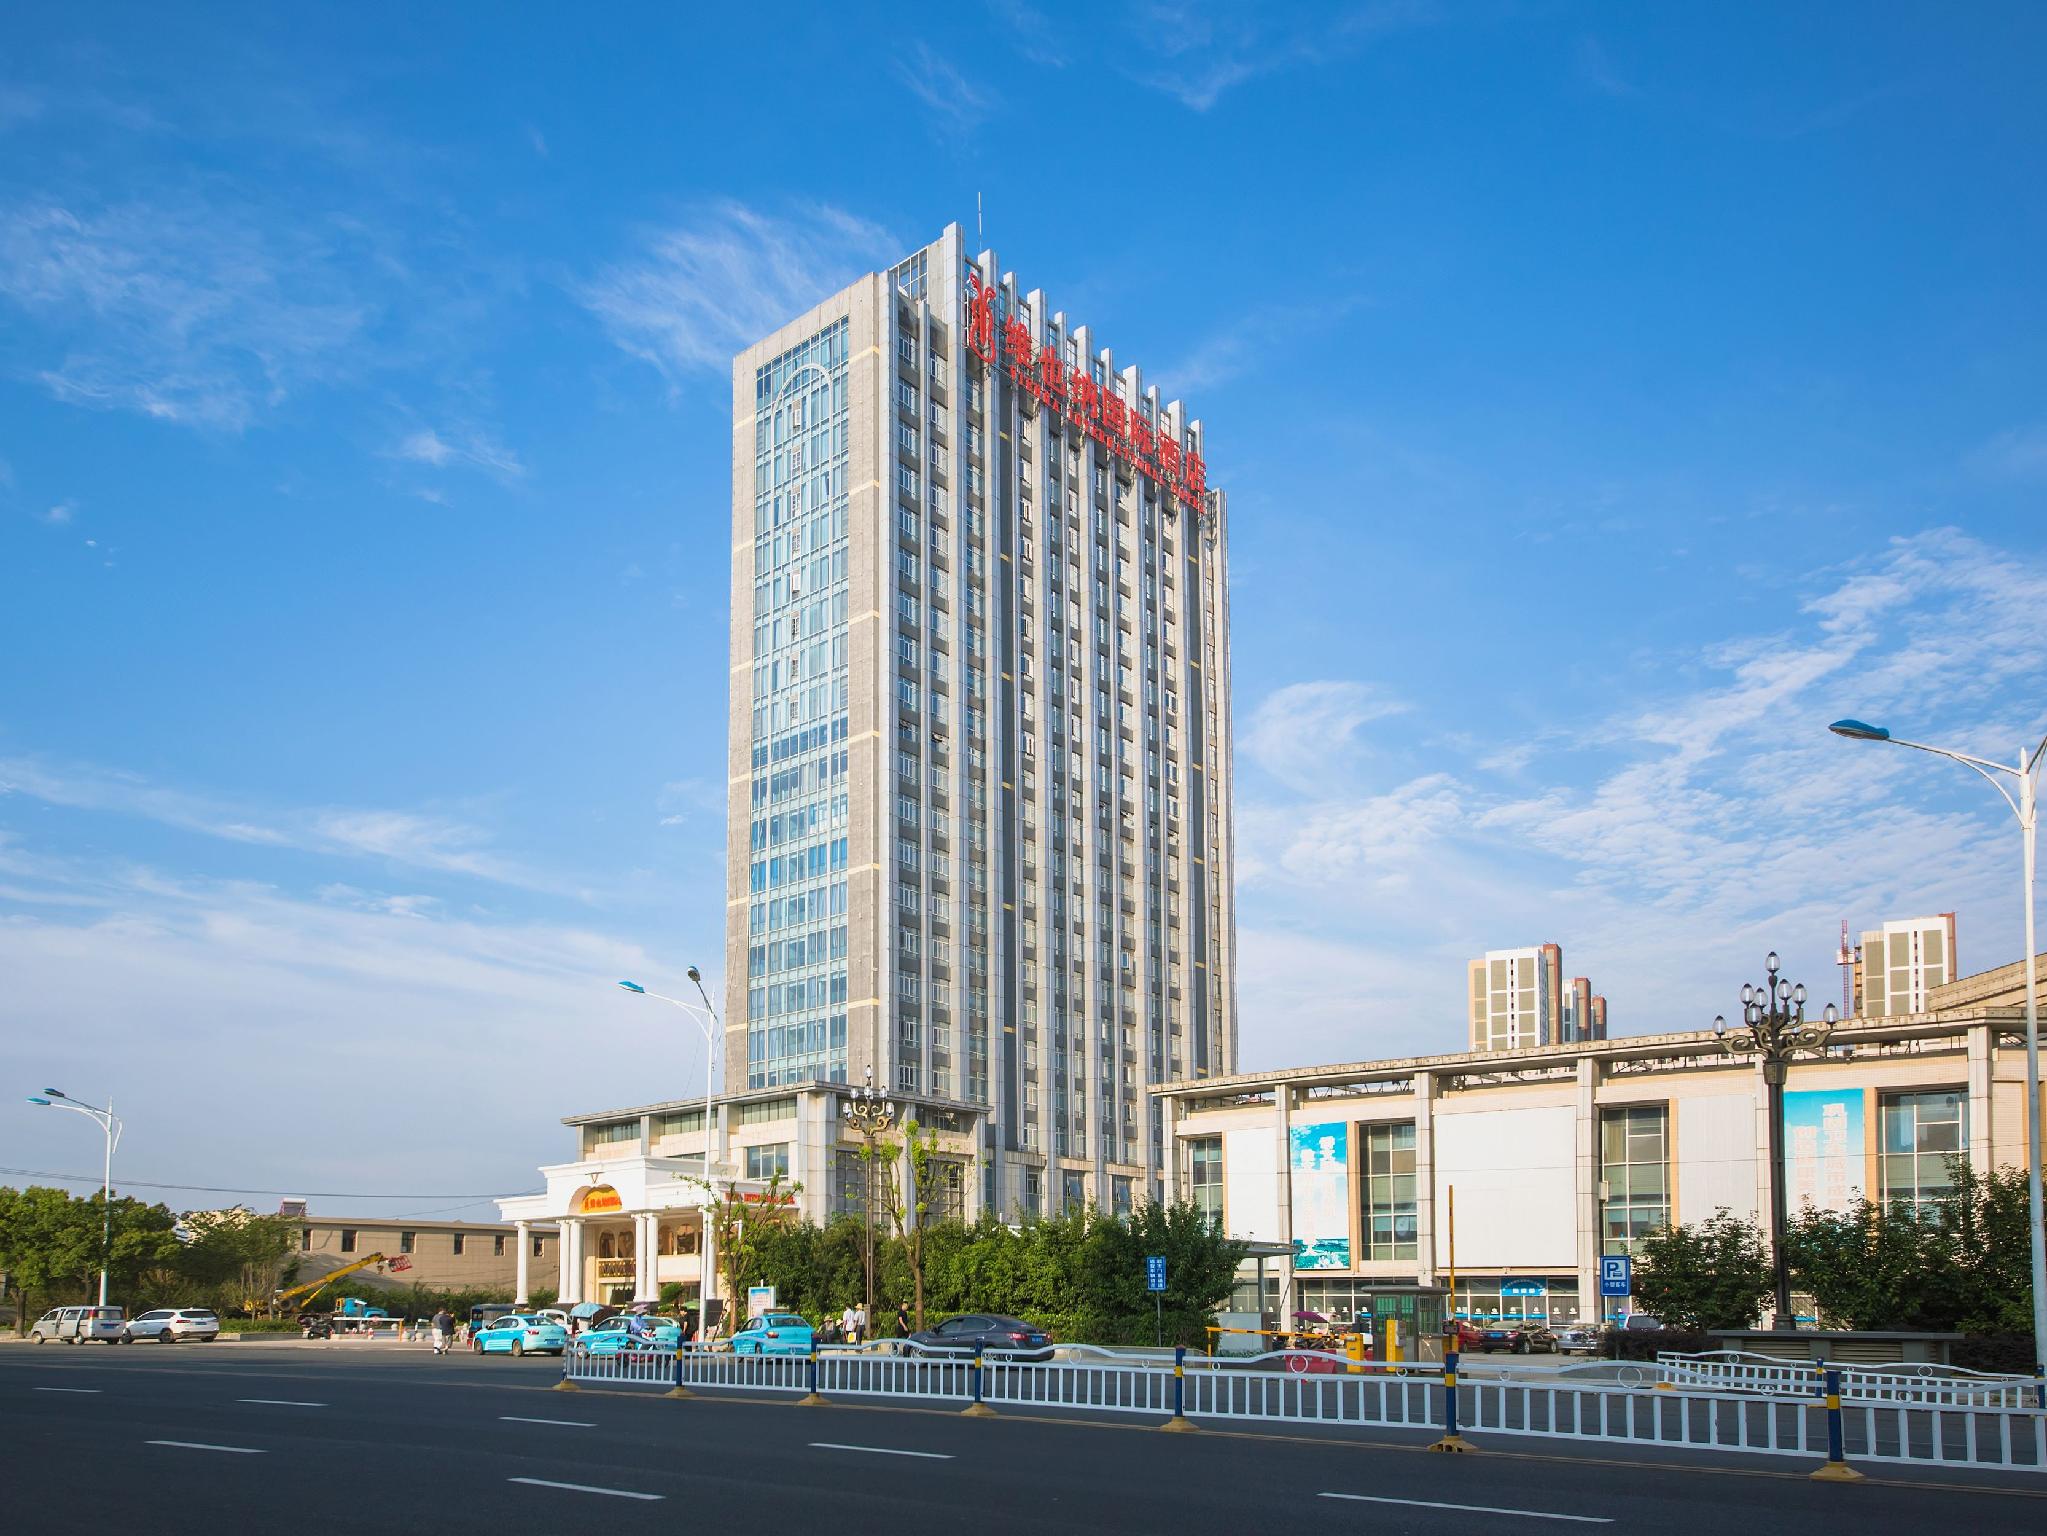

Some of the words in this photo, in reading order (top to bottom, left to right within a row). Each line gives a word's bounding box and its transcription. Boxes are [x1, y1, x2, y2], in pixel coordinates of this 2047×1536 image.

[1005, 315, 1207, 496] 维也纳国际酒店
[1607, 1262, 1619, 1277] P
